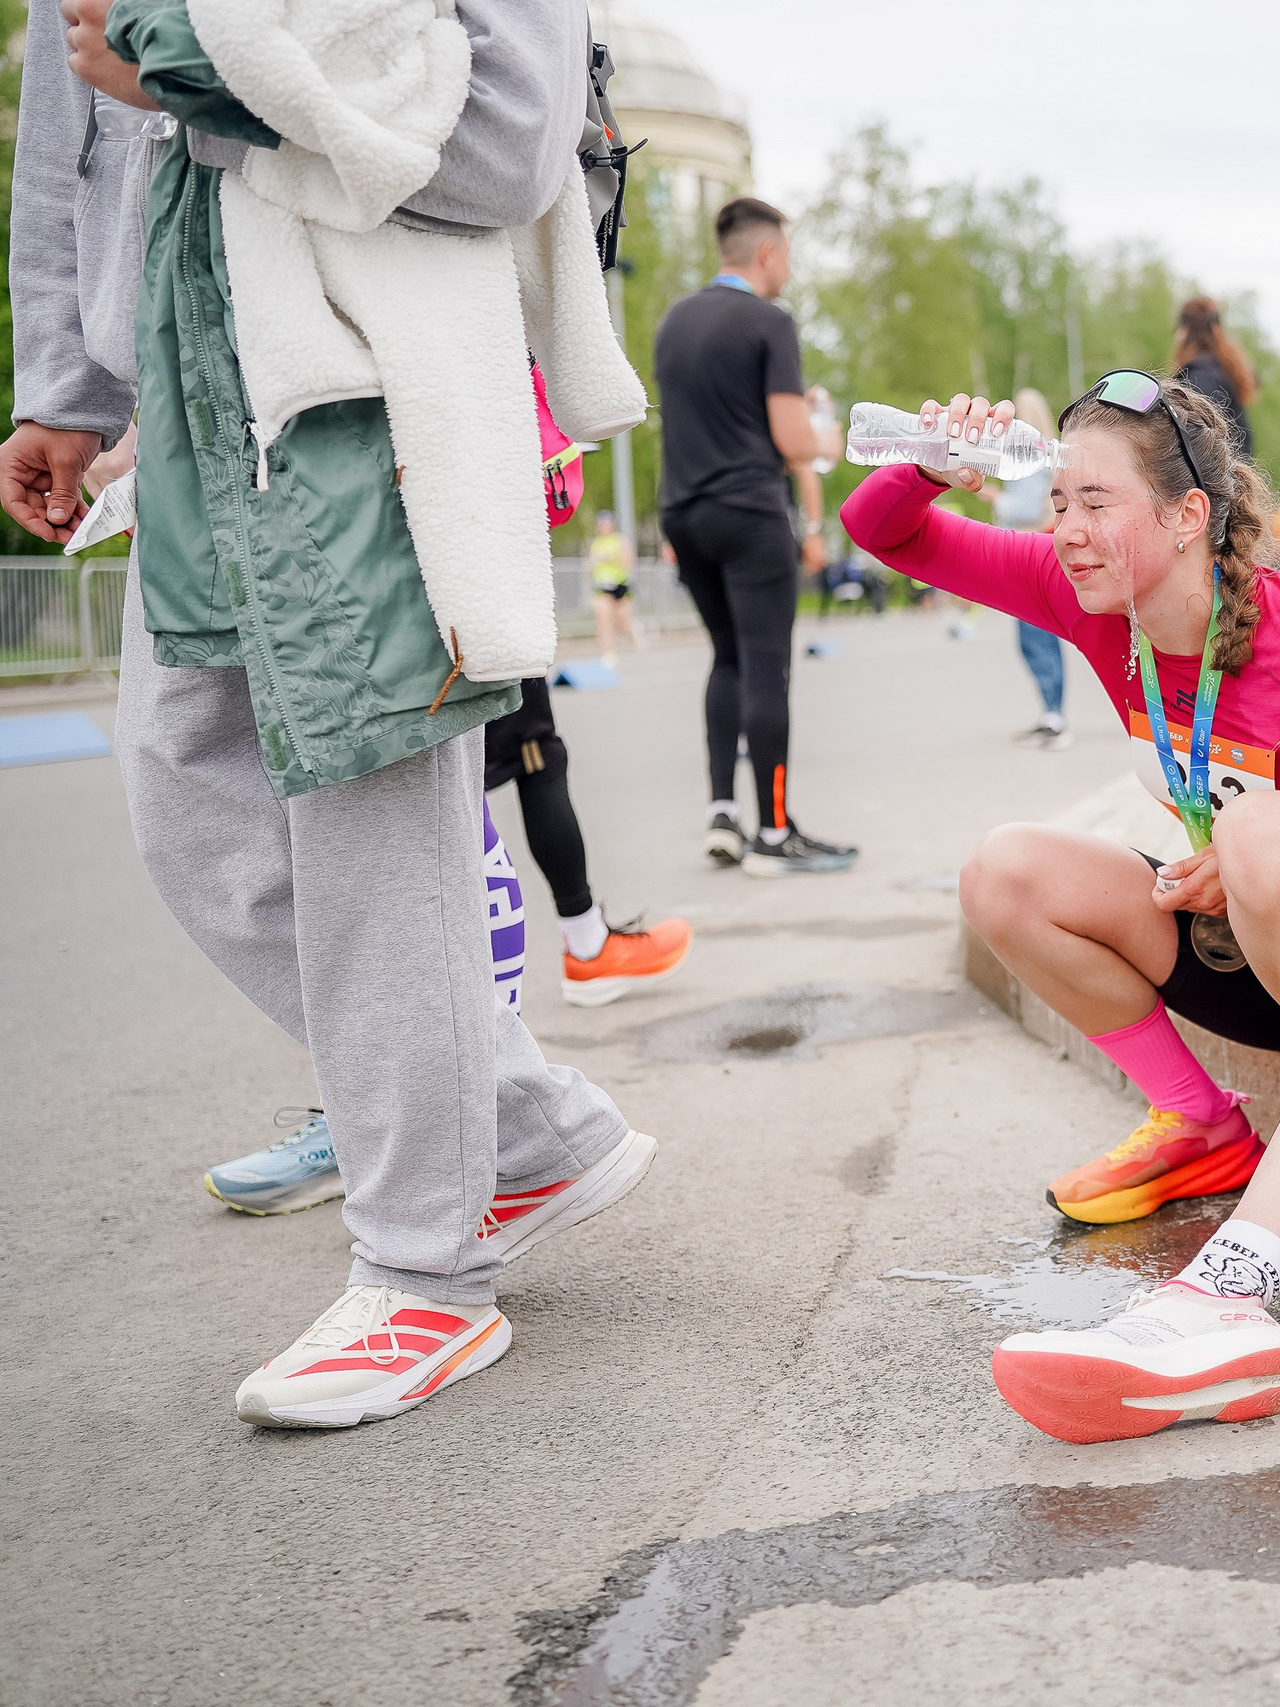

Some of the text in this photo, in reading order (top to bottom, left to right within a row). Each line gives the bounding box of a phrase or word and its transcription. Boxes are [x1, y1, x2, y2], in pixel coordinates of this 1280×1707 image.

[1156, 725, 1166, 744] Utair
[1168, 731, 1183, 742] БЕР
[1198, 729, 1206, 747] Utair
[1172, 777, 1184, 801] СБЕР
[1196, 775, 1205, 796] СБЕР
[1212, 1238, 1260, 1260] СЕВЕР
